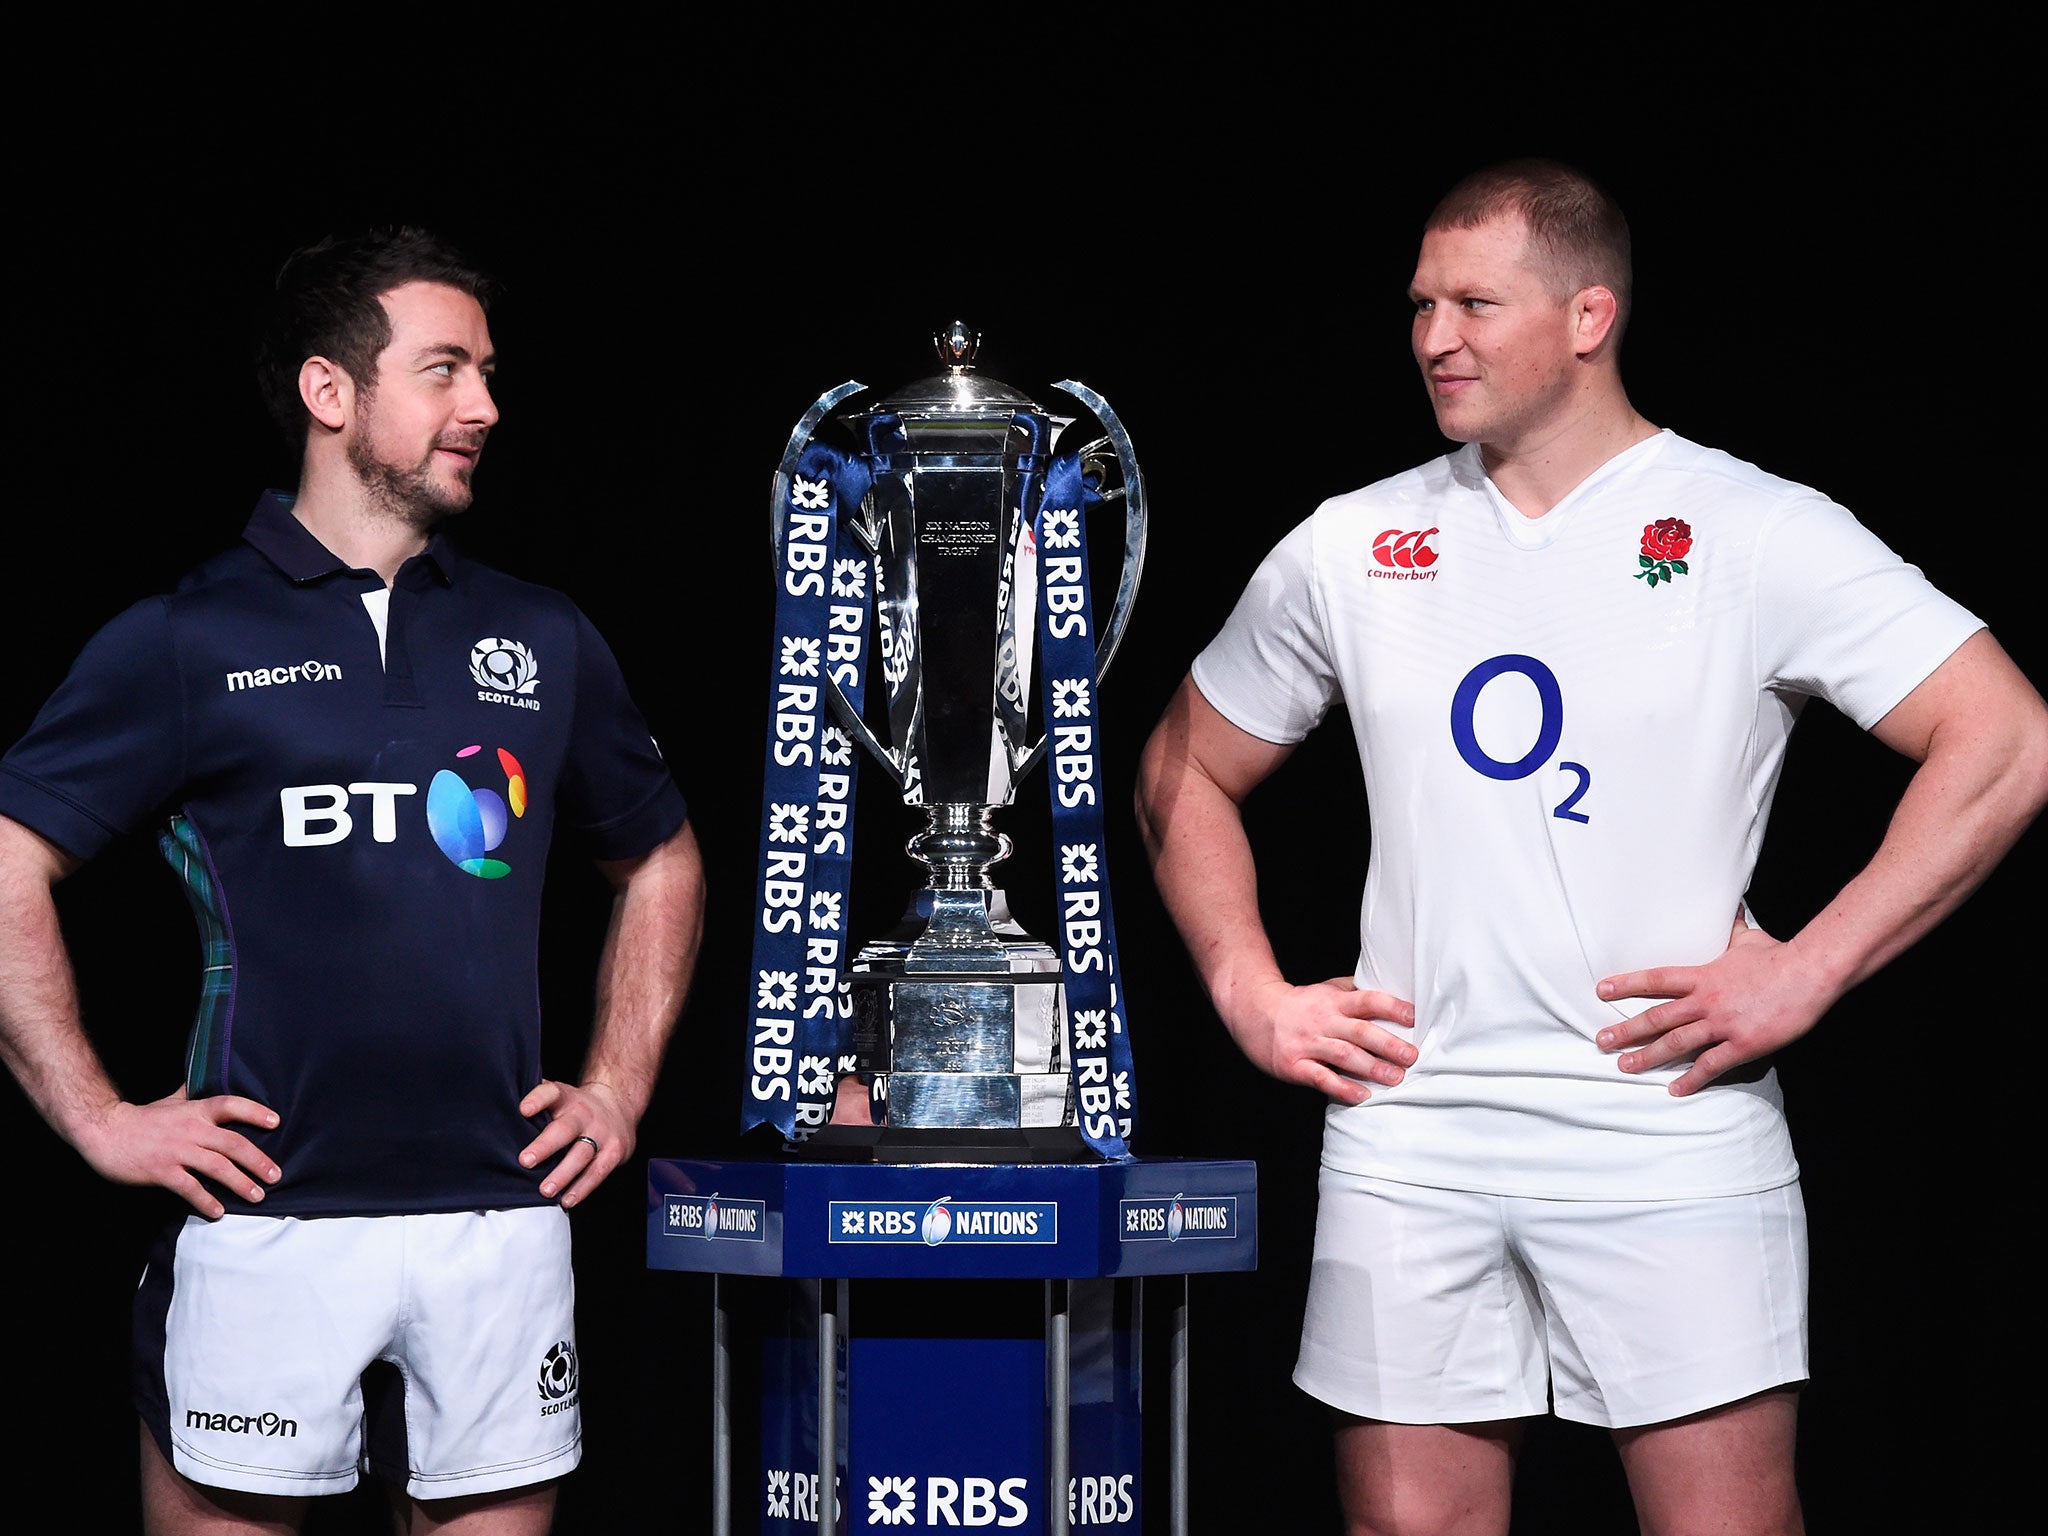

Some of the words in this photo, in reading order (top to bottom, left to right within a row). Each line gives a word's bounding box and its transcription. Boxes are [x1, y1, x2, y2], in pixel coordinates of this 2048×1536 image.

[920, 534, 997, 544] CHAMPIONSHIP
[926, 521, 943, 531] SIX
[944, 521, 990, 531] NATIONS
[937, 546, 980, 556] TROPHY
[786, 513, 830, 597] RBS
[1367, 569, 1438, 582] canterbury
[1045, 556, 1087, 639] RBS
[828, 605, 864, 687] RBS
[226, 660, 343, 692] macron
[477, 690, 541, 711] SCOTLAND
[773, 683, 818, 768] RBS
[1451, 654, 1591, 824] O2
[1054, 725, 1096, 808] RBS
[280, 782, 418, 847] BT
[763, 850, 807, 934] RBS
[1063, 890, 1104, 974] RBS
[751, 1017, 795, 1102] RBS
[1076, 1057, 1116, 1139] RBS
[681, 1205, 703, 1229] RBS
[719, 1207, 757, 1232] NATIONS
[868, 1211, 917, 1235] RBS
[956, 1211, 1039, 1235] NATIONS
[1140, 1208, 1166, 1231] RBS
[1185, 1207, 1227, 1230] NATIONS
[186, 1409, 298, 1438] macron
[927, 1477, 1029, 1527] RBS
[1081, 1474, 1134, 1525] RBS
